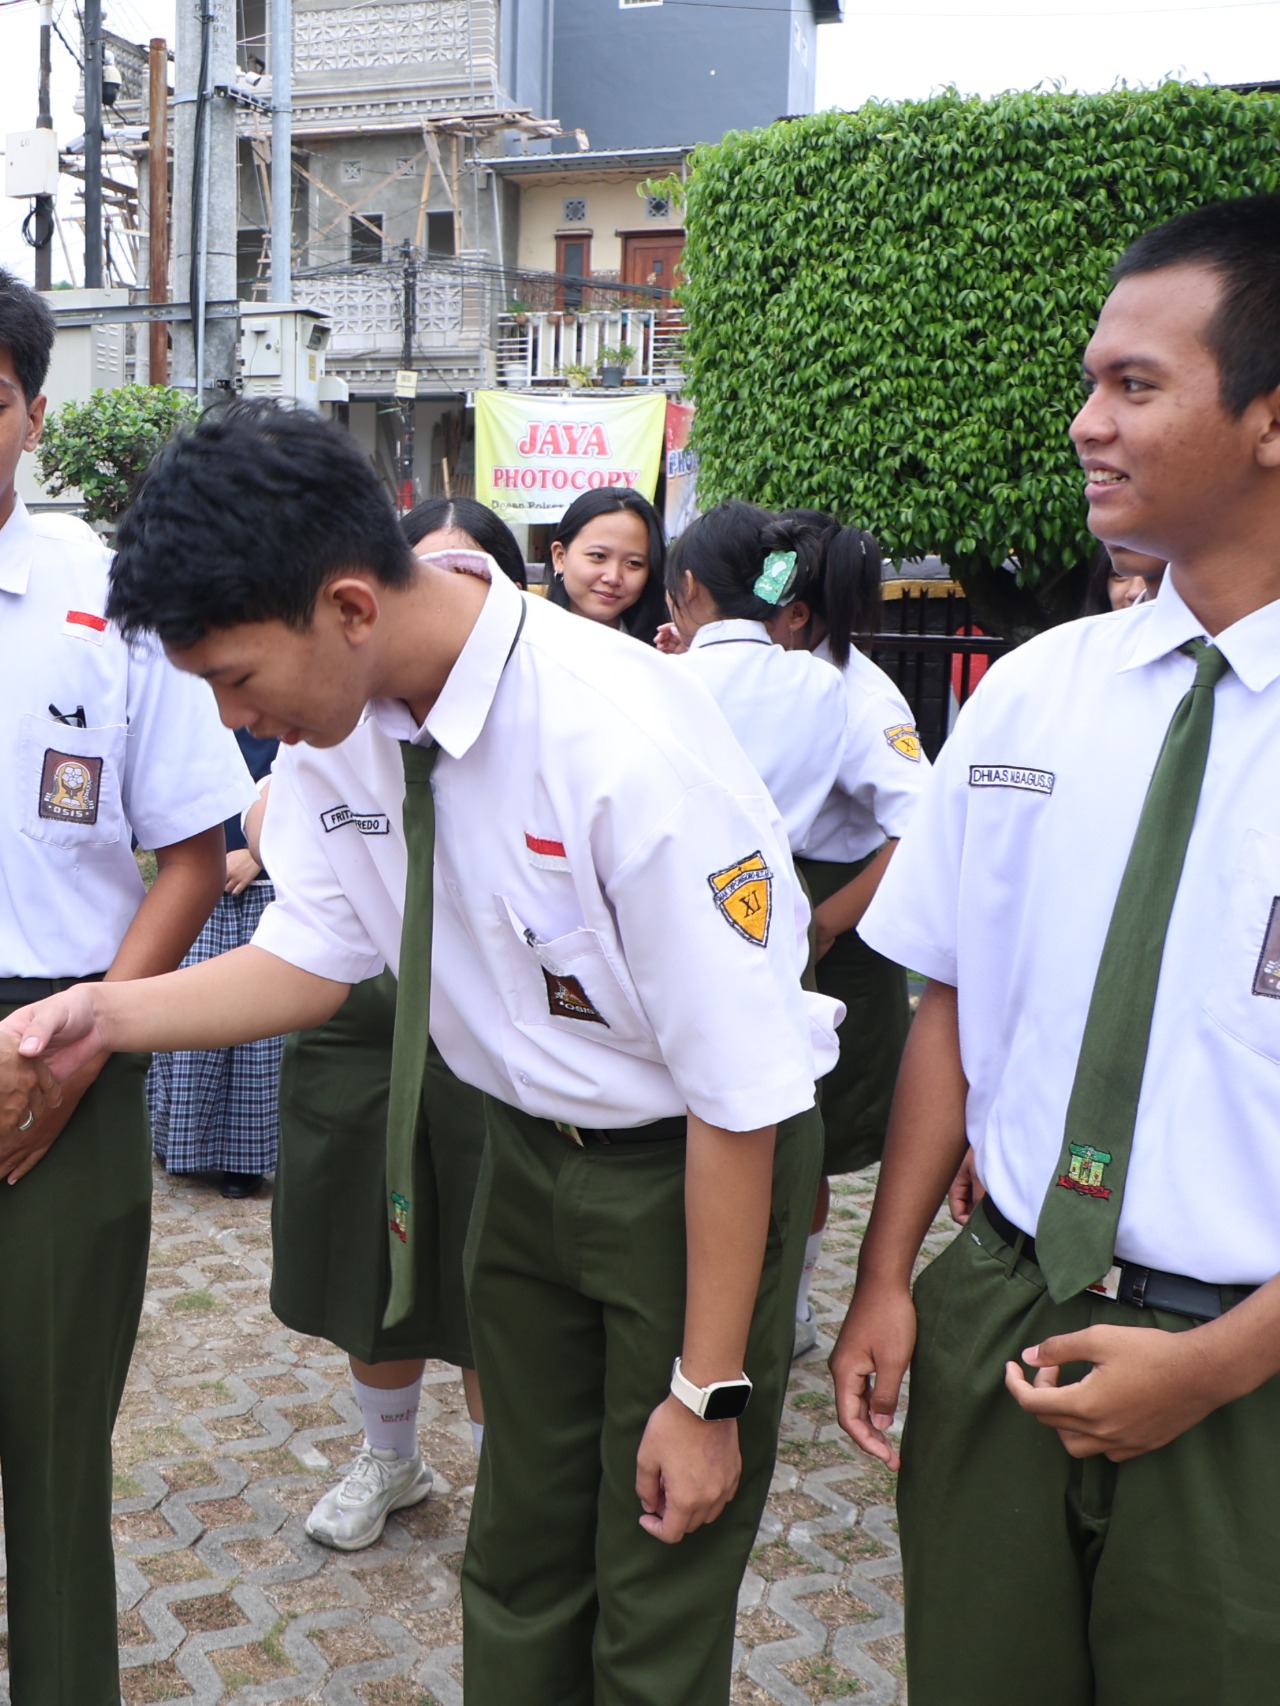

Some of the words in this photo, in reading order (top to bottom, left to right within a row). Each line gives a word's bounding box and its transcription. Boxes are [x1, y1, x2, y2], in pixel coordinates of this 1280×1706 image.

[517, 421, 612, 458] JAYA
[492, 466, 640, 490] PHOTOCOPY
[53, 806, 83, 818] OSIS
[739, 890, 762, 918] XI
